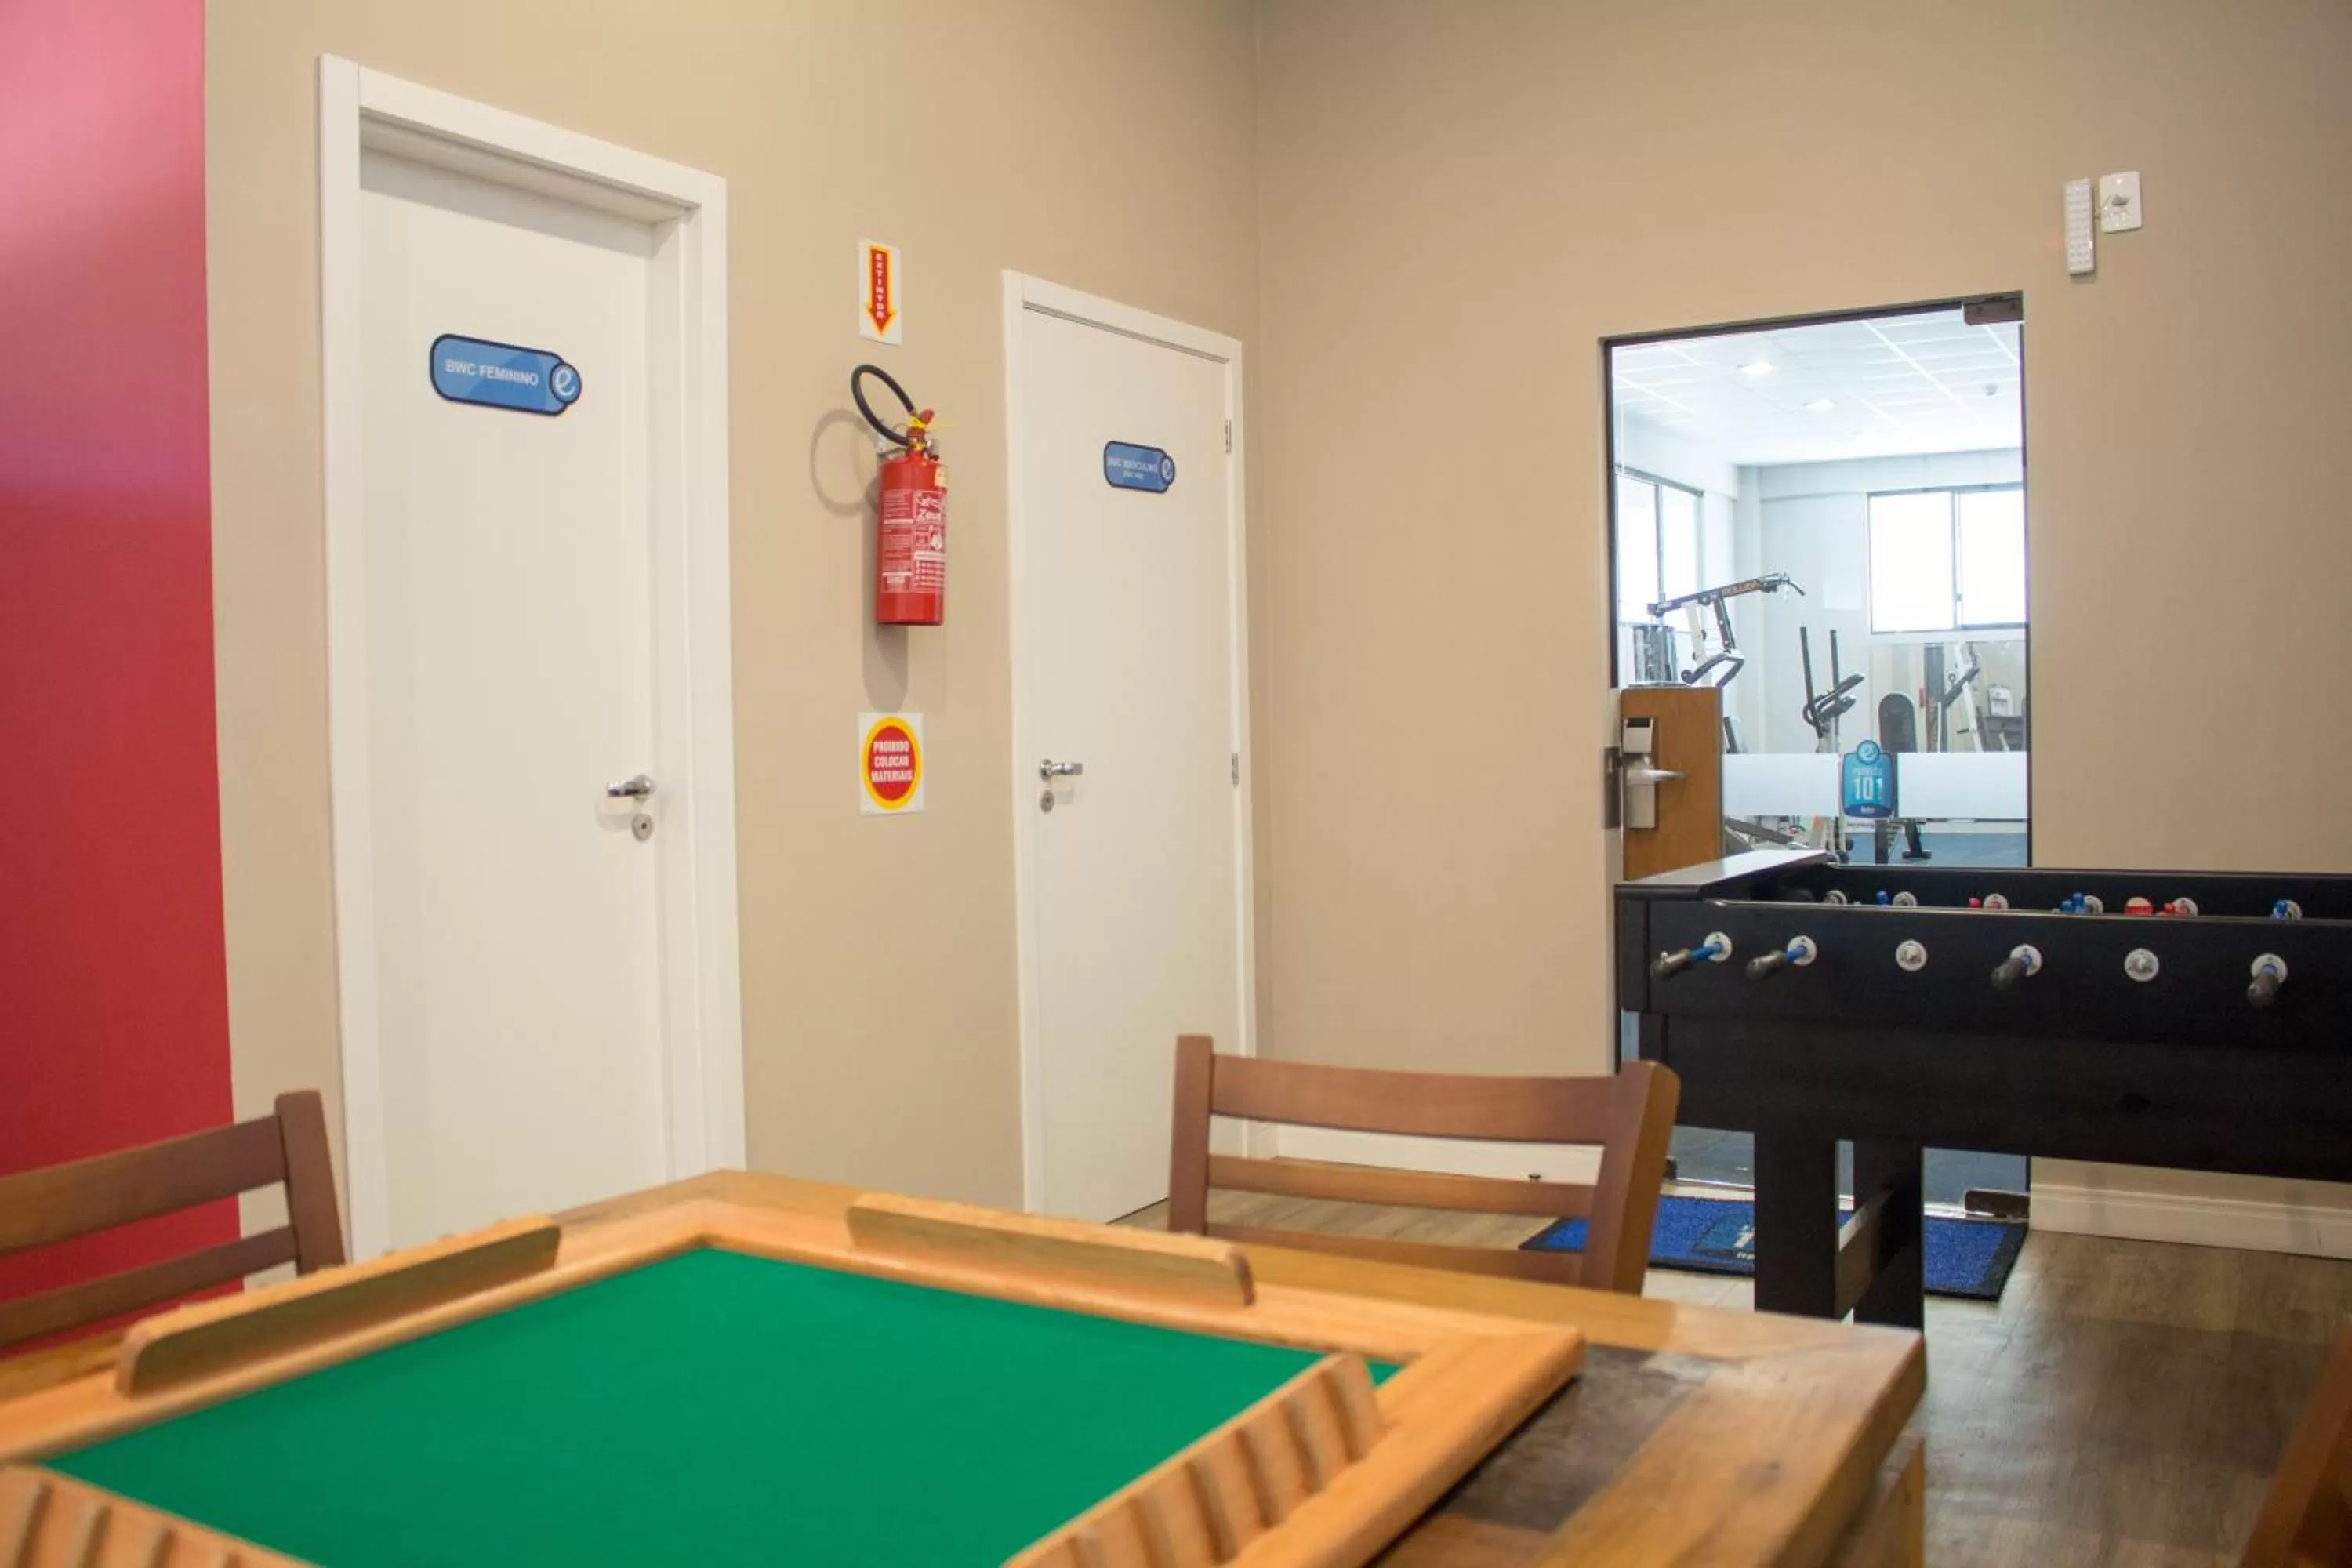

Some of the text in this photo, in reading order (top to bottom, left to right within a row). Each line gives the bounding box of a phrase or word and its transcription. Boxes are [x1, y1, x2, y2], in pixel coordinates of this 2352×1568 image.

[445, 358, 539, 387] BWC FEMININO
[873, 739, 910, 753] PROIBIDO
[874, 754, 909, 768] COLOCAR
[871, 768, 913, 782] MATERIAIS
